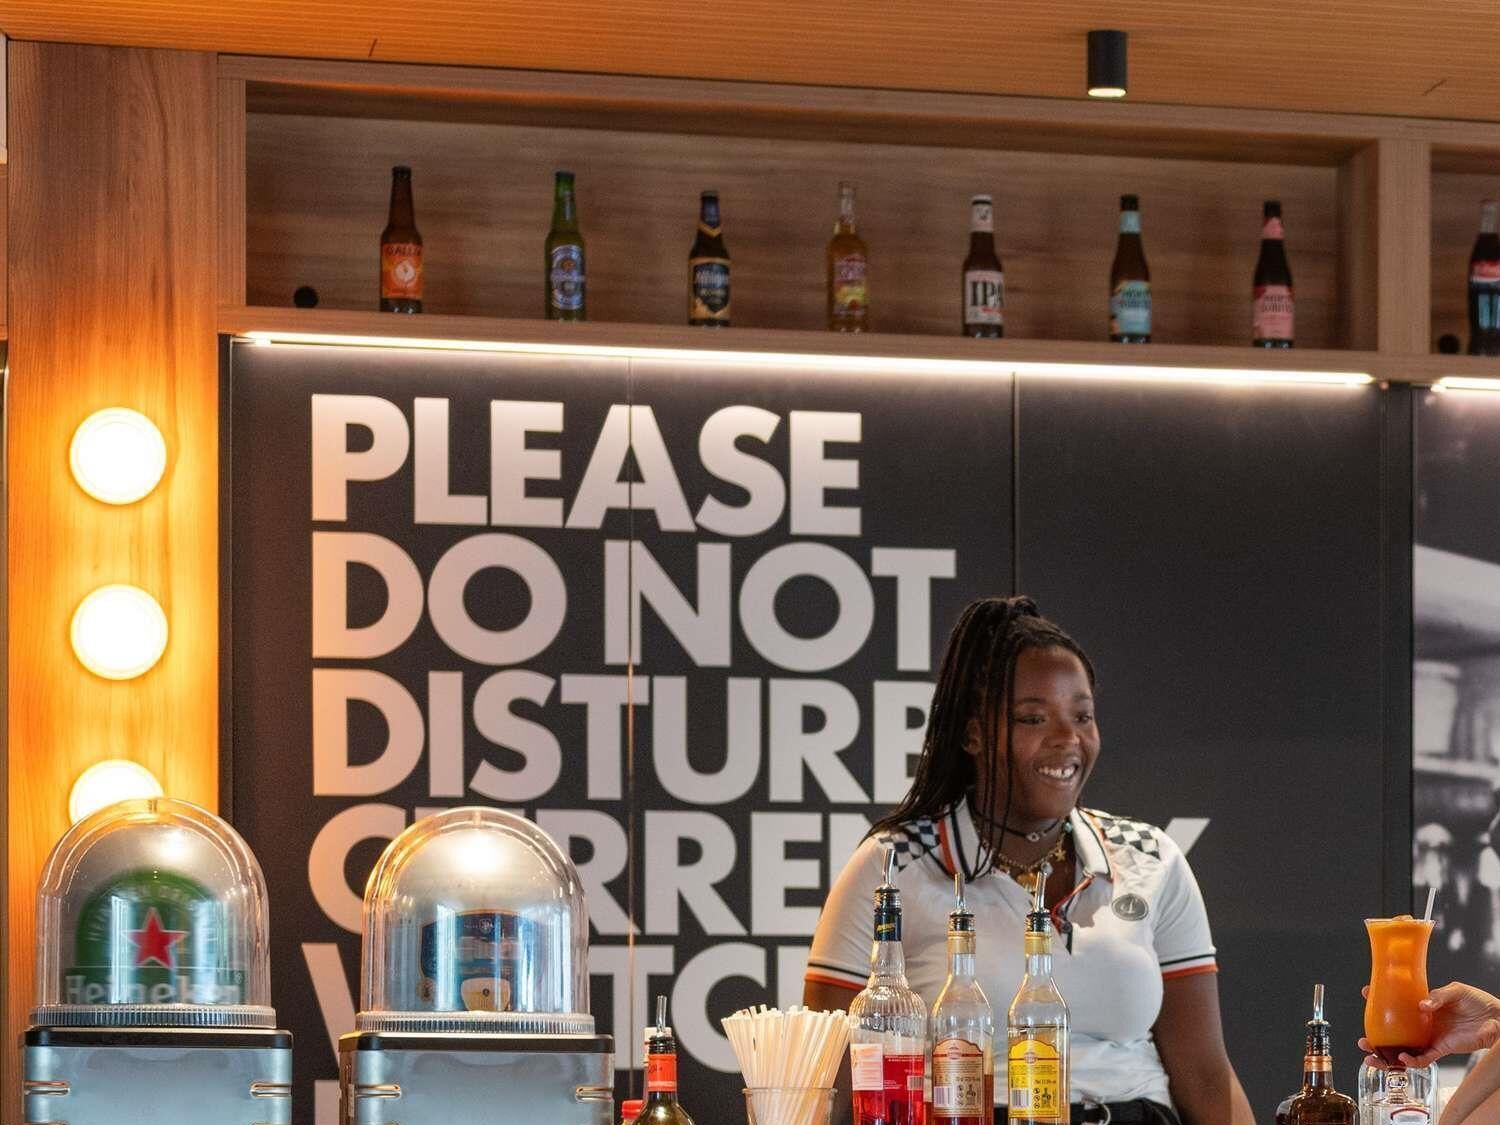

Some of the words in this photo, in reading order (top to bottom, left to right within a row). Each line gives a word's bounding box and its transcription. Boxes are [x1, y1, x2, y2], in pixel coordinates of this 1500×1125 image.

[311, 393, 863, 537] PLEASE
[311, 530, 567, 666] DO
[604, 538, 956, 673] NOT
[311, 667, 937, 805] DISTURB
